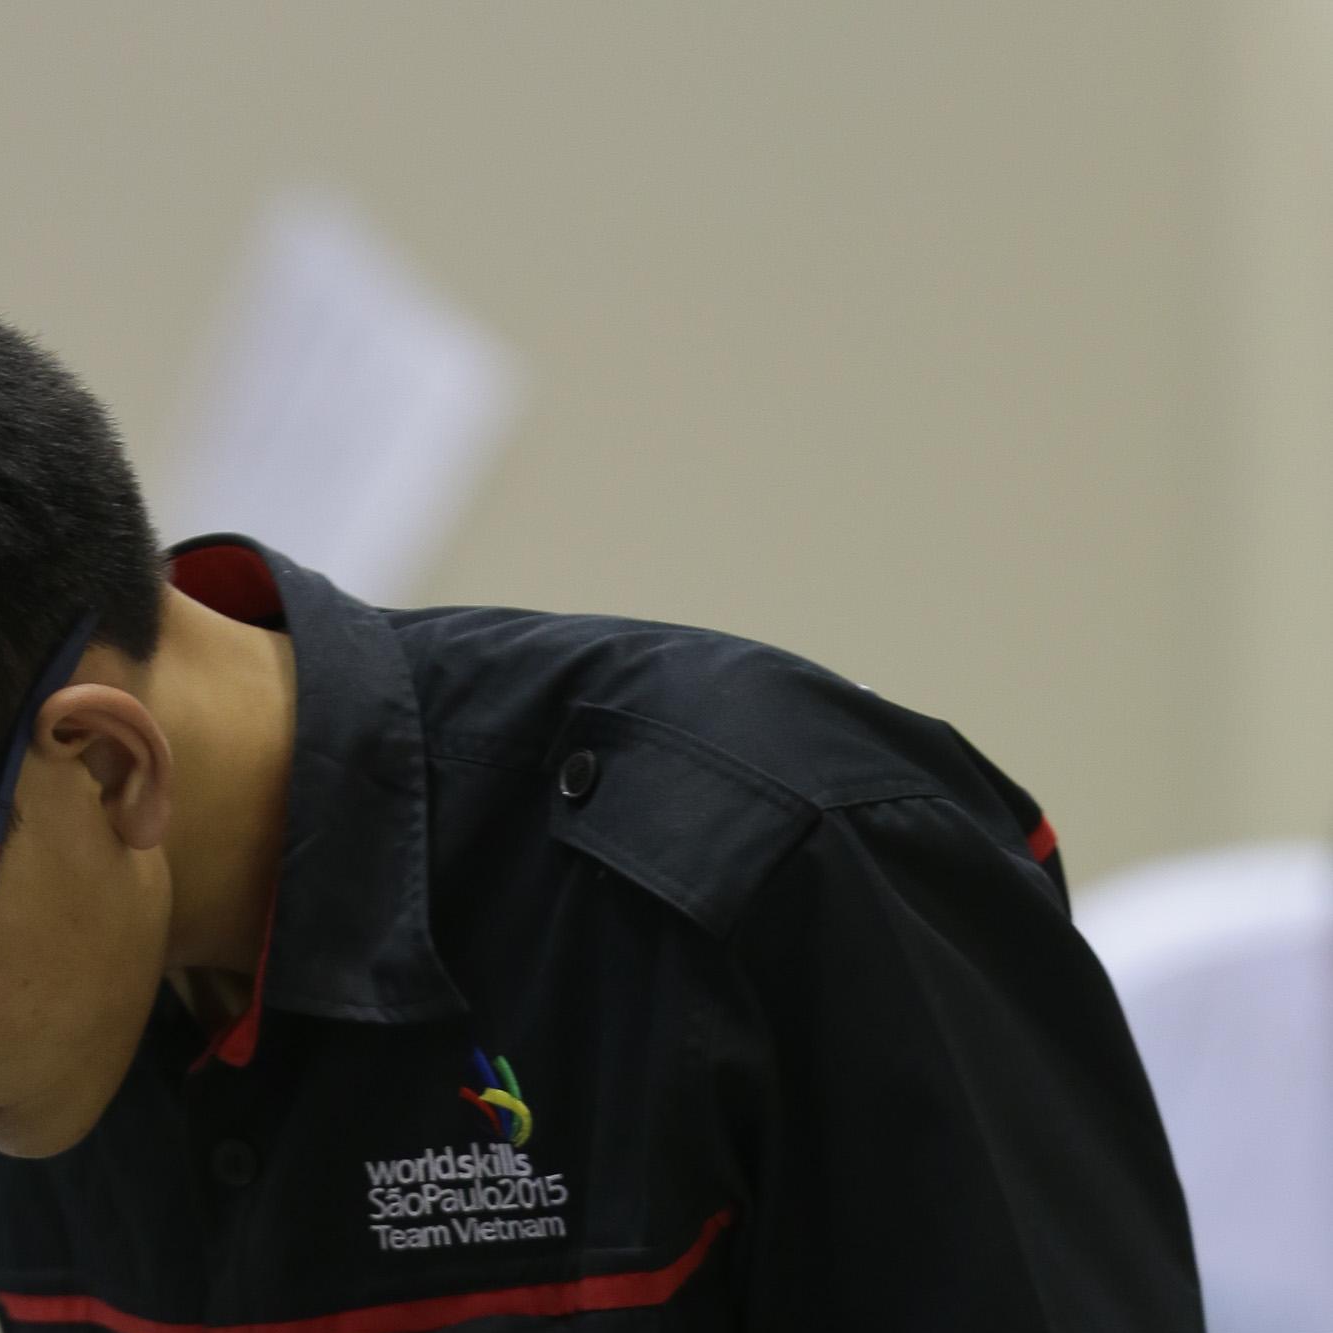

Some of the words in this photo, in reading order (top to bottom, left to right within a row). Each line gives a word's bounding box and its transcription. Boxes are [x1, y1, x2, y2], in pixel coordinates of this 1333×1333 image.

[365, 1142, 533, 1186] worldskills
[368, 1173, 568, 1220] SãoPaulo2015
[370, 1225, 452, 1251] Team
[451, 1214, 566, 1244] Vietnam
